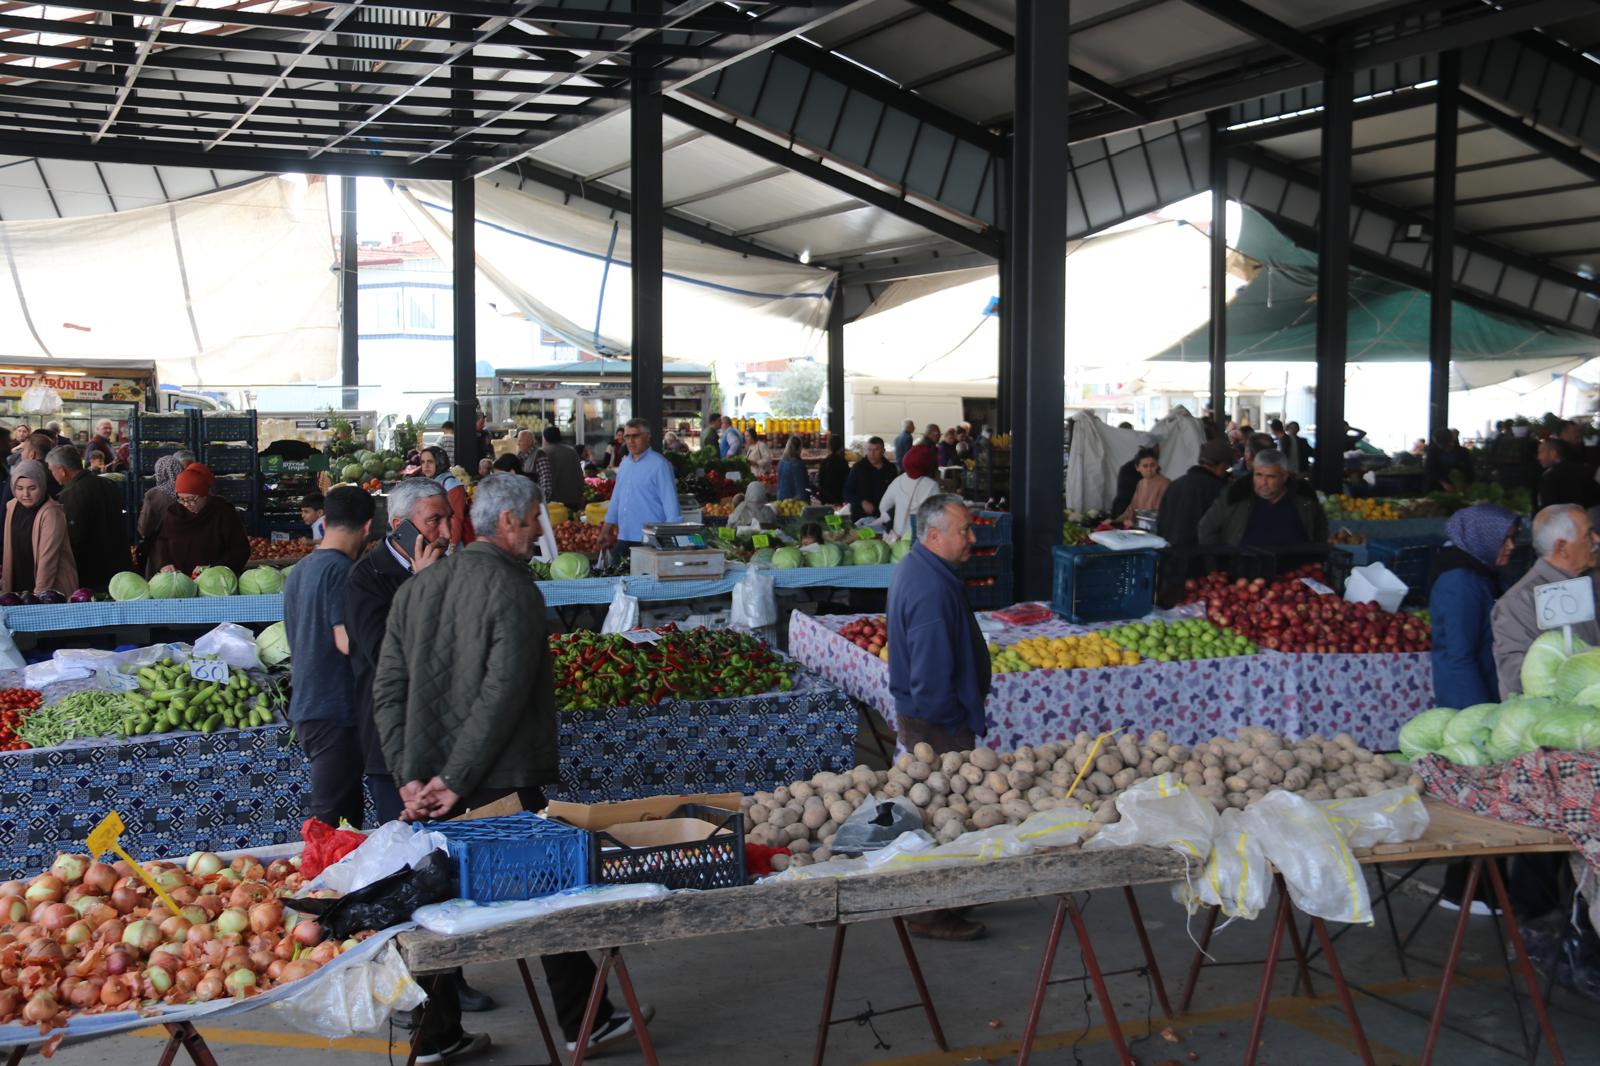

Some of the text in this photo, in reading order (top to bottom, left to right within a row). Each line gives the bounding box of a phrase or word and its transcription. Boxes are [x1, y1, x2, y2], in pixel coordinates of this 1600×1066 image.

[10, 373, 36, 388] SÜT
[38, 375, 103, 391] ÜRÜNLERİ
[1543, 593, 1578, 621] 60
[195, 664, 224, 680] 60
